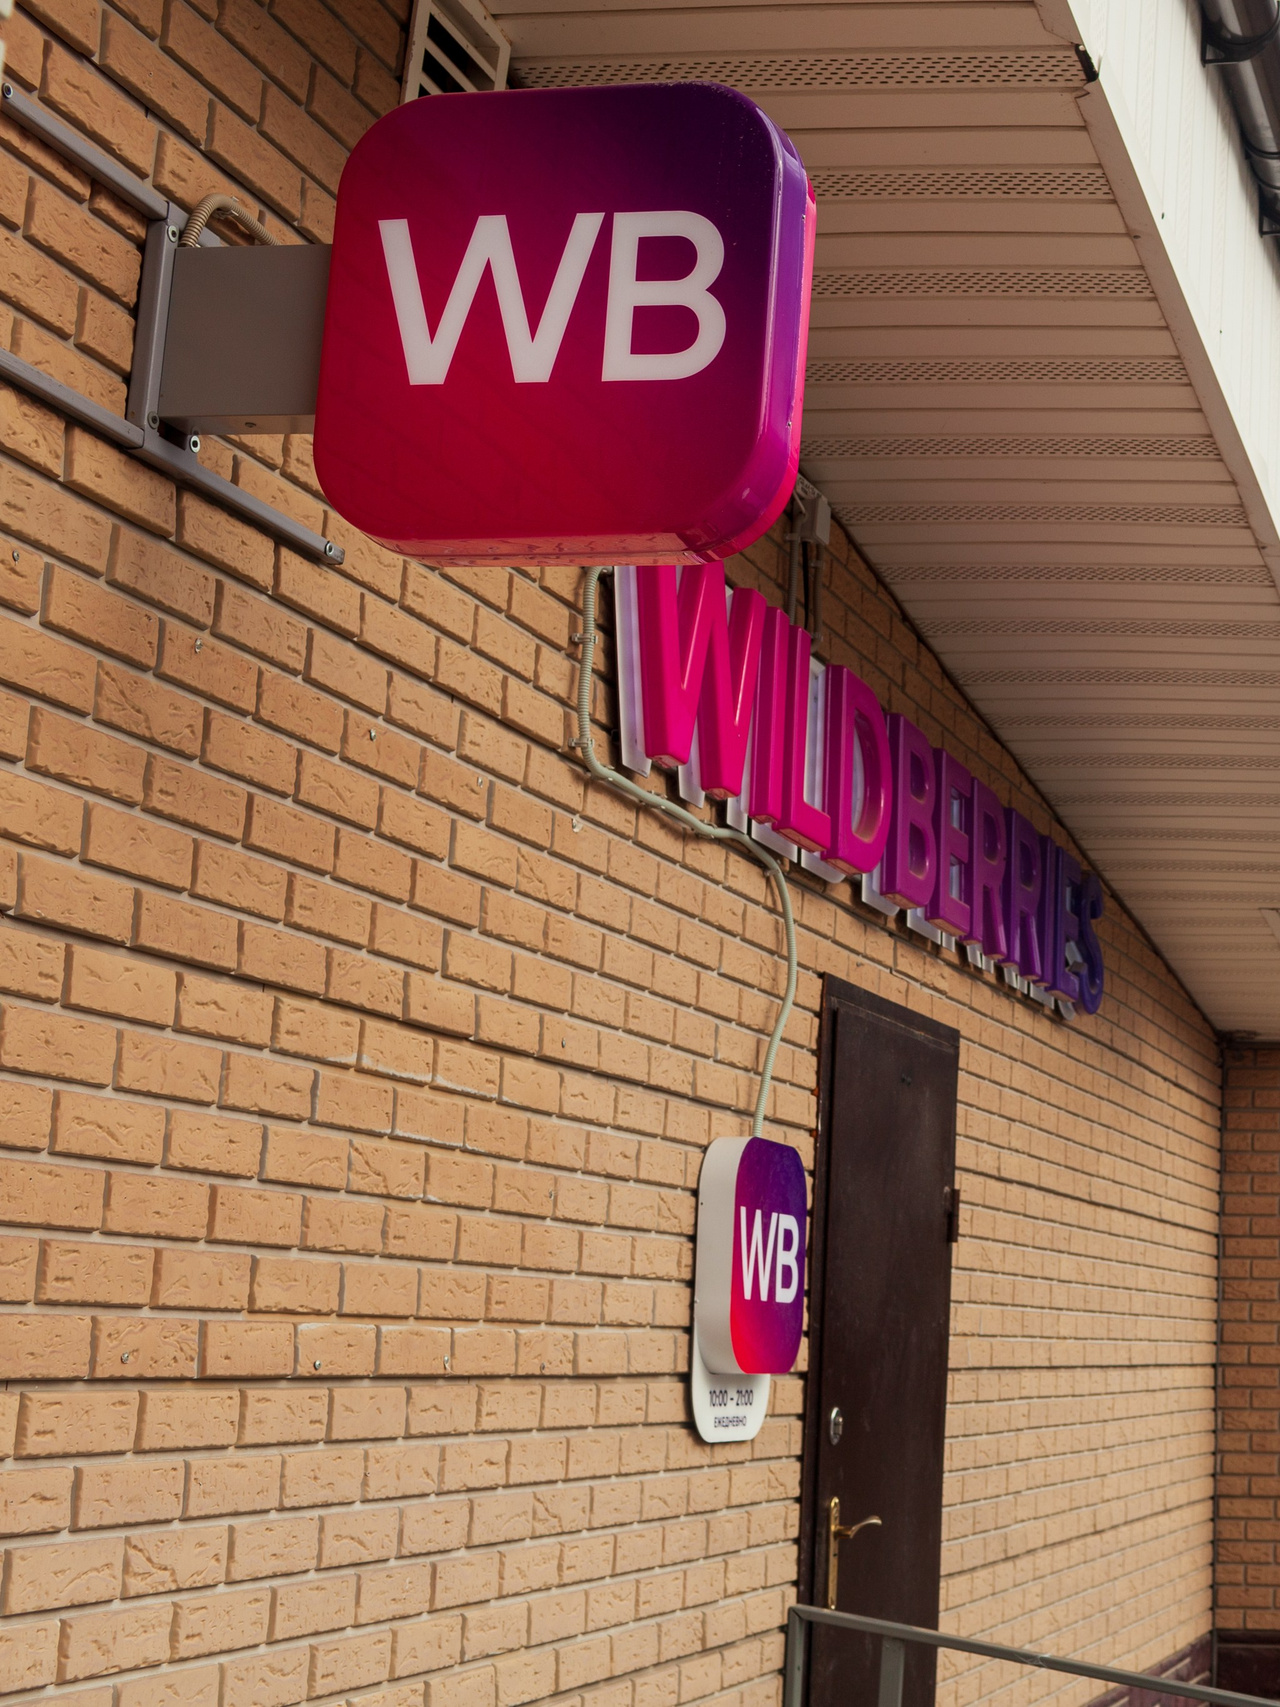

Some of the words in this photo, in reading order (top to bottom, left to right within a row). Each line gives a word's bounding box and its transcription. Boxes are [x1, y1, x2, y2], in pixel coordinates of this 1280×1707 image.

[378, 210, 726, 385] WB
[632, 560, 1104, 1016] WILDBERRIES
[740, 1206, 800, 1304] WB
[709, 1389, 728, 1407] 10:00
[736, 1389, 754, 1406] 21:00
